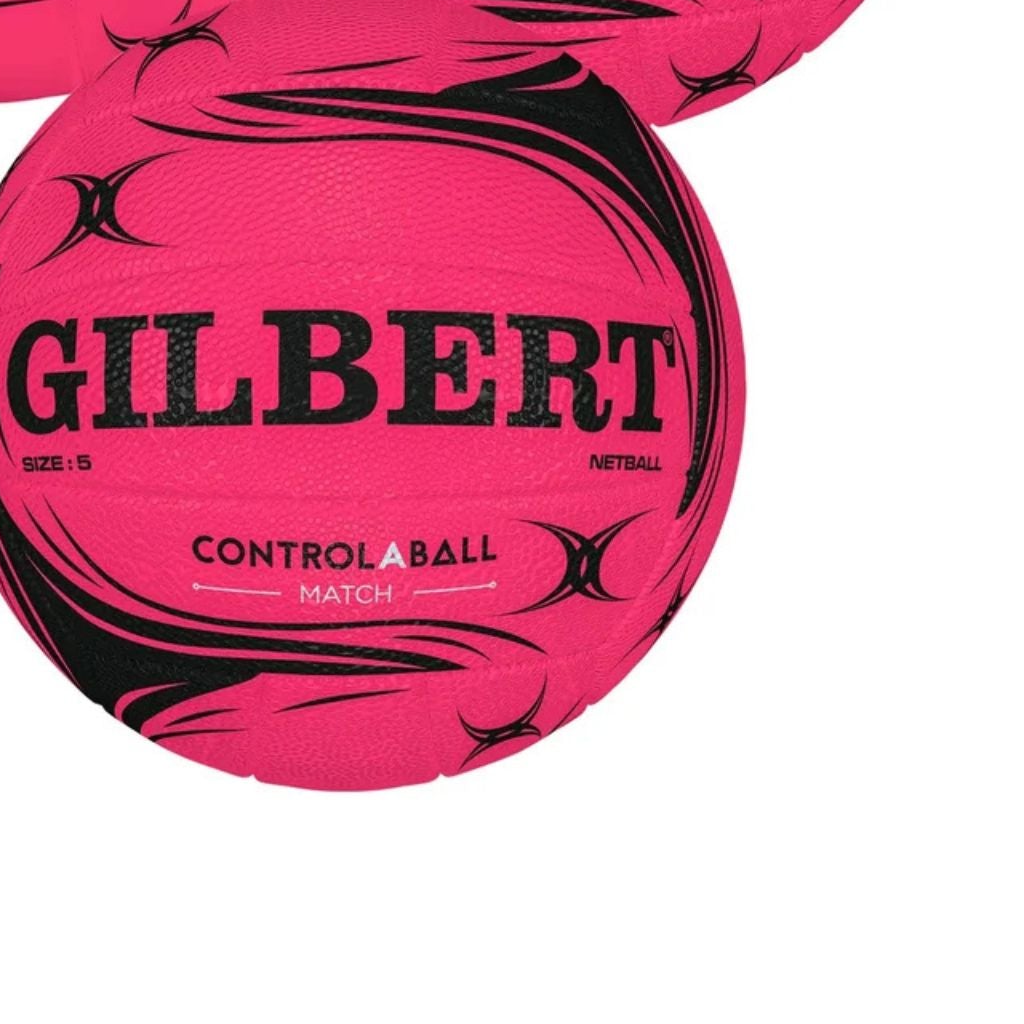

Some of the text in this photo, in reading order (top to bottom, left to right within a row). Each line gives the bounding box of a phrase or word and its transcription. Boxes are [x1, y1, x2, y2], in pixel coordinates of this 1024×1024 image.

[76, 454, 92, 472] 5
[589, 454, 662, 472] NETBALL
[299, 583, 393, 605] MATCH
